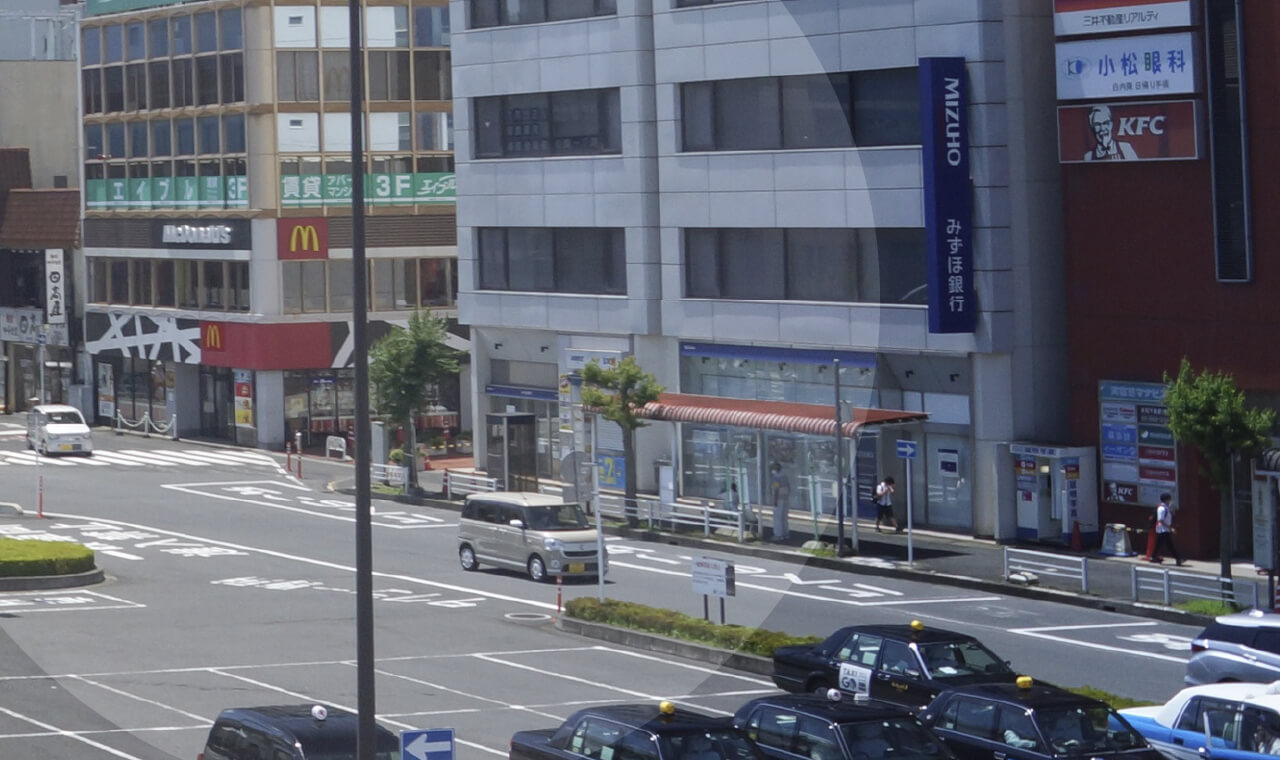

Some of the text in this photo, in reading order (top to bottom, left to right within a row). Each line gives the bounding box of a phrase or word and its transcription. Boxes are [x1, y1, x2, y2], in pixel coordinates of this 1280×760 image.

[1083, 10, 1158, 26] 三井不動産リアルティ
[1098, 50, 1185, 77] 小松眼科
[944, 77, 961, 167] MIZUHO
[1117, 115, 1165, 136] KFC
[113, 180, 193, 200] エイブル
[228, 177, 248, 200] 3F
[281, 176, 322, 198] 賃貸
[327, 175, 352, 185] アパー
[376, 176, 411, 196] 3F
[327, 187, 352, 196] マンシ
[946, 218, 964, 312] みずほ銀行
[843, 667, 857, 677] TAXI
